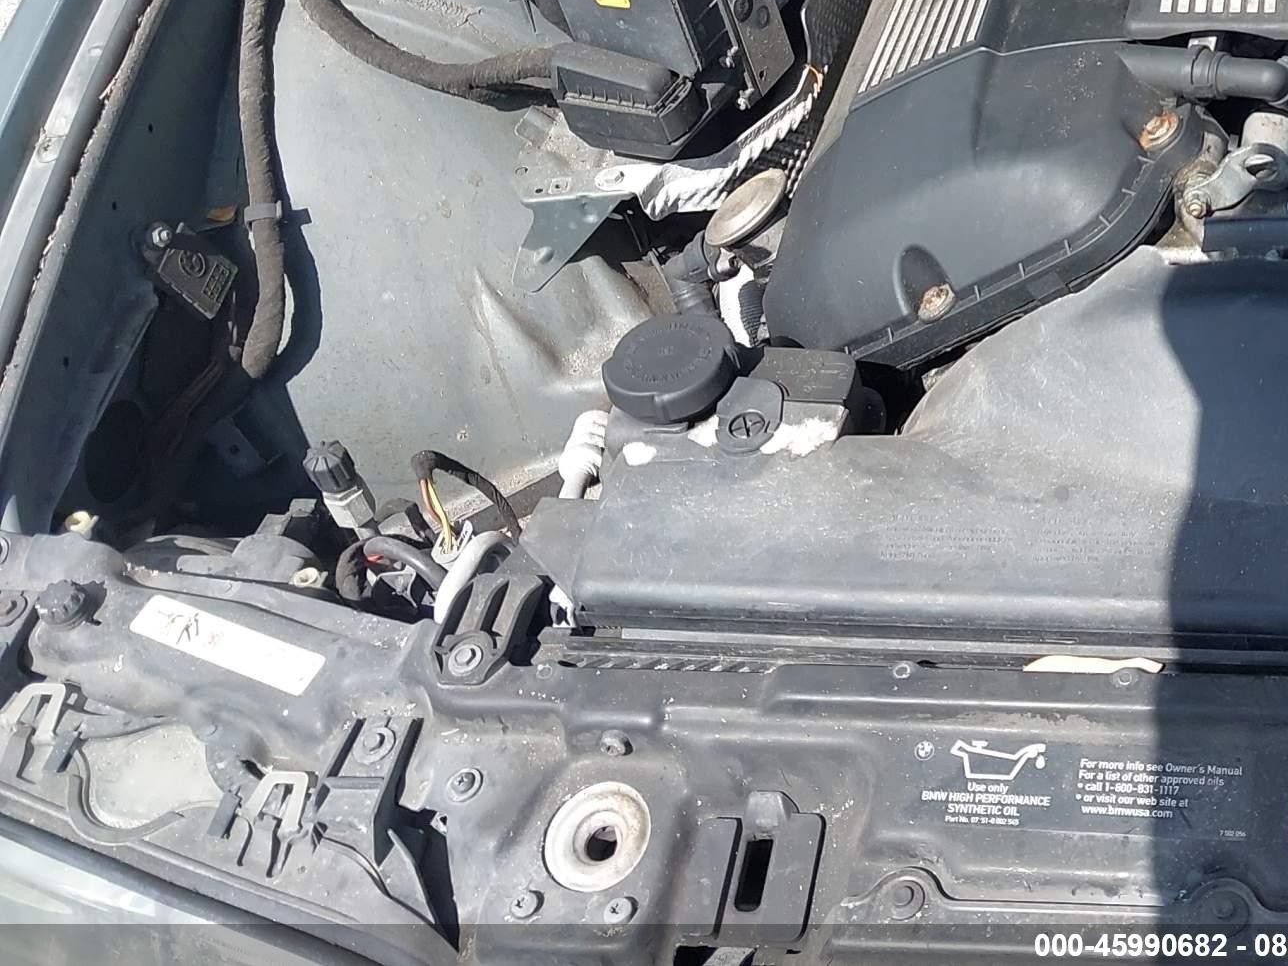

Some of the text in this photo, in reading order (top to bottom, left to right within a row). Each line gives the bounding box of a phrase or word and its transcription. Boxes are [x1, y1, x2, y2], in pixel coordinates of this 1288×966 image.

[1079, 758, 1243, 776] For more info see Owner's Manual
[1078, 769, 1225, 787] For a list of other approved oils
[967, 782, 1009, 795] Use only
[1085, 782, 1103, 792] call
[921, 791, 1052, 807] BMW HIGH PERFORMANCE
[1083, 793, 1189, 808] or visit our web site at
[947, 803, 1021, 817] SYNTHETIC OIL
[1080, 804, 1173, 818] www.bmwusa.com
[944, 815, 959, 823] Part
